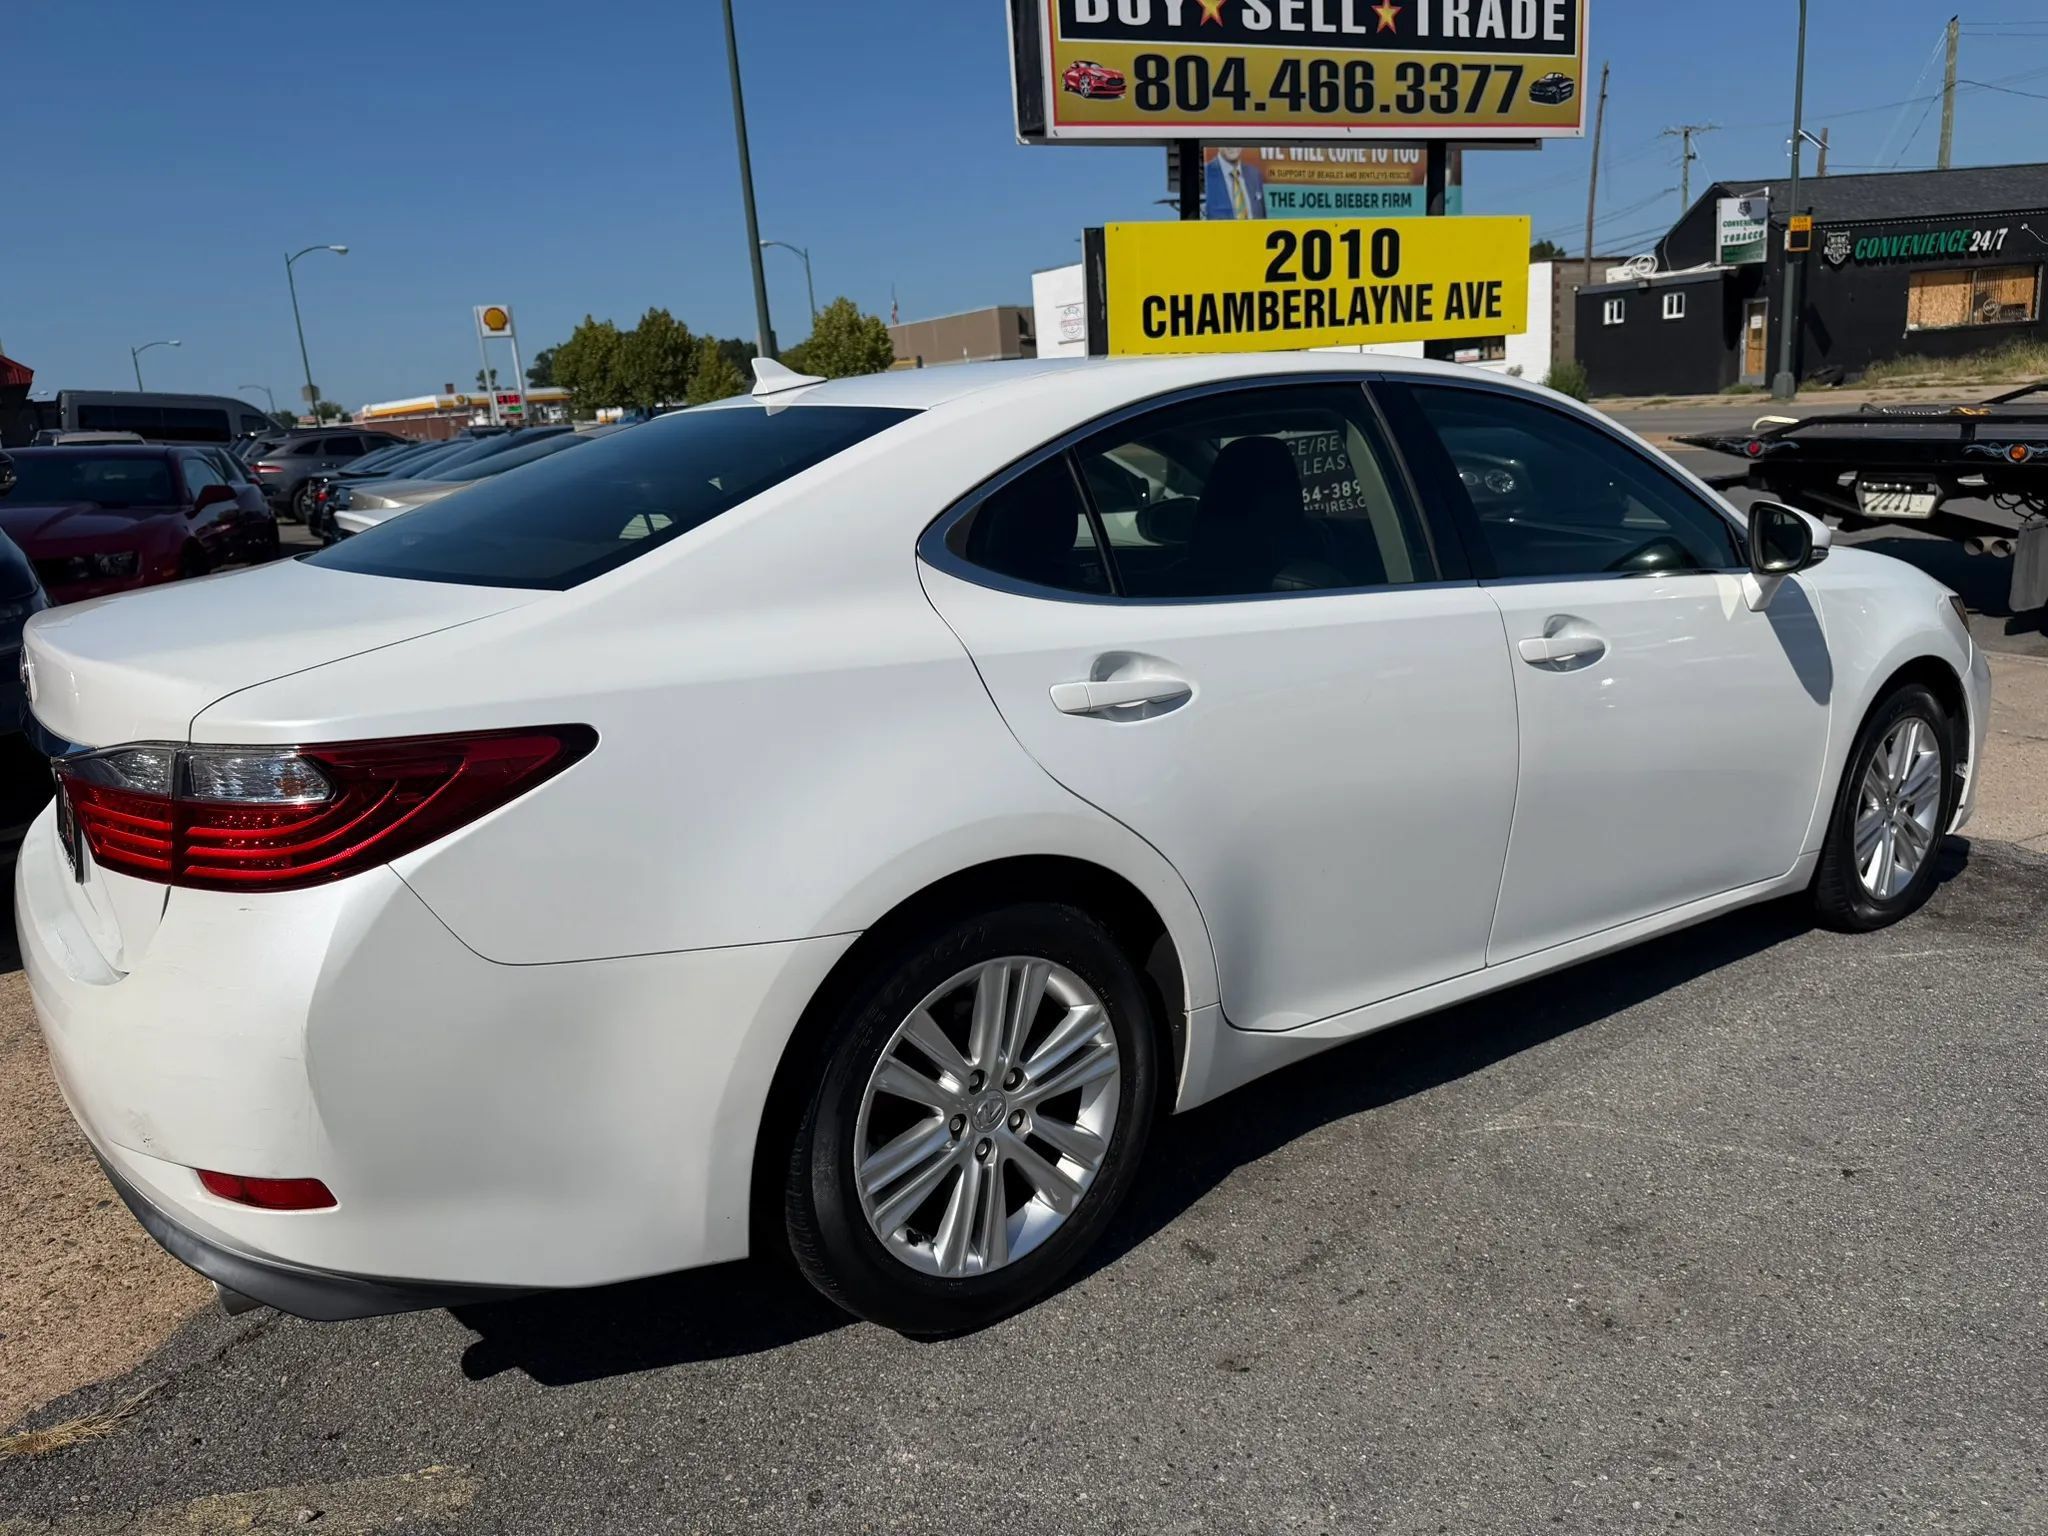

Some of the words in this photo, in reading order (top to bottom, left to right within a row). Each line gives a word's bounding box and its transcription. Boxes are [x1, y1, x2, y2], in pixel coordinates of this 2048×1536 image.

[1241, 0, 1366, 34] SELL
[1416, 0, 1565, 41] TRADE
[1132, 53, 1524, 114] 804.466.3377
[1260, 147, 1284, 160] WE
[1289, 147, 1324, 162] WILL
[1328, 148, 1366, 163] COME
[1371, 148, 1388, 163] TO
[1393, 148, 1419, 164] YOU
[1277, 169, 1306, 177] SUPPORT
[1269, 192, 1296, 207] THE
[1298, 192, 1332, 208] JOEL
[1335, 192, 1379, 208] BIEBER
[1382, 192, 1412, 208] FIRM
[1723, 230, 1764, 243] TOBACCO
[1854, 229, 1972, 260] CONVENIENCE
[1968, 227, 2009, 252] 24/7
[1264, 227, 1400, 283] 2010
[1142, 283, 1433, 339] CHAMBERLAYNE
[1444, 280, 1503, 321] AVE
[1303, 453, 1350, 475] LEAS
